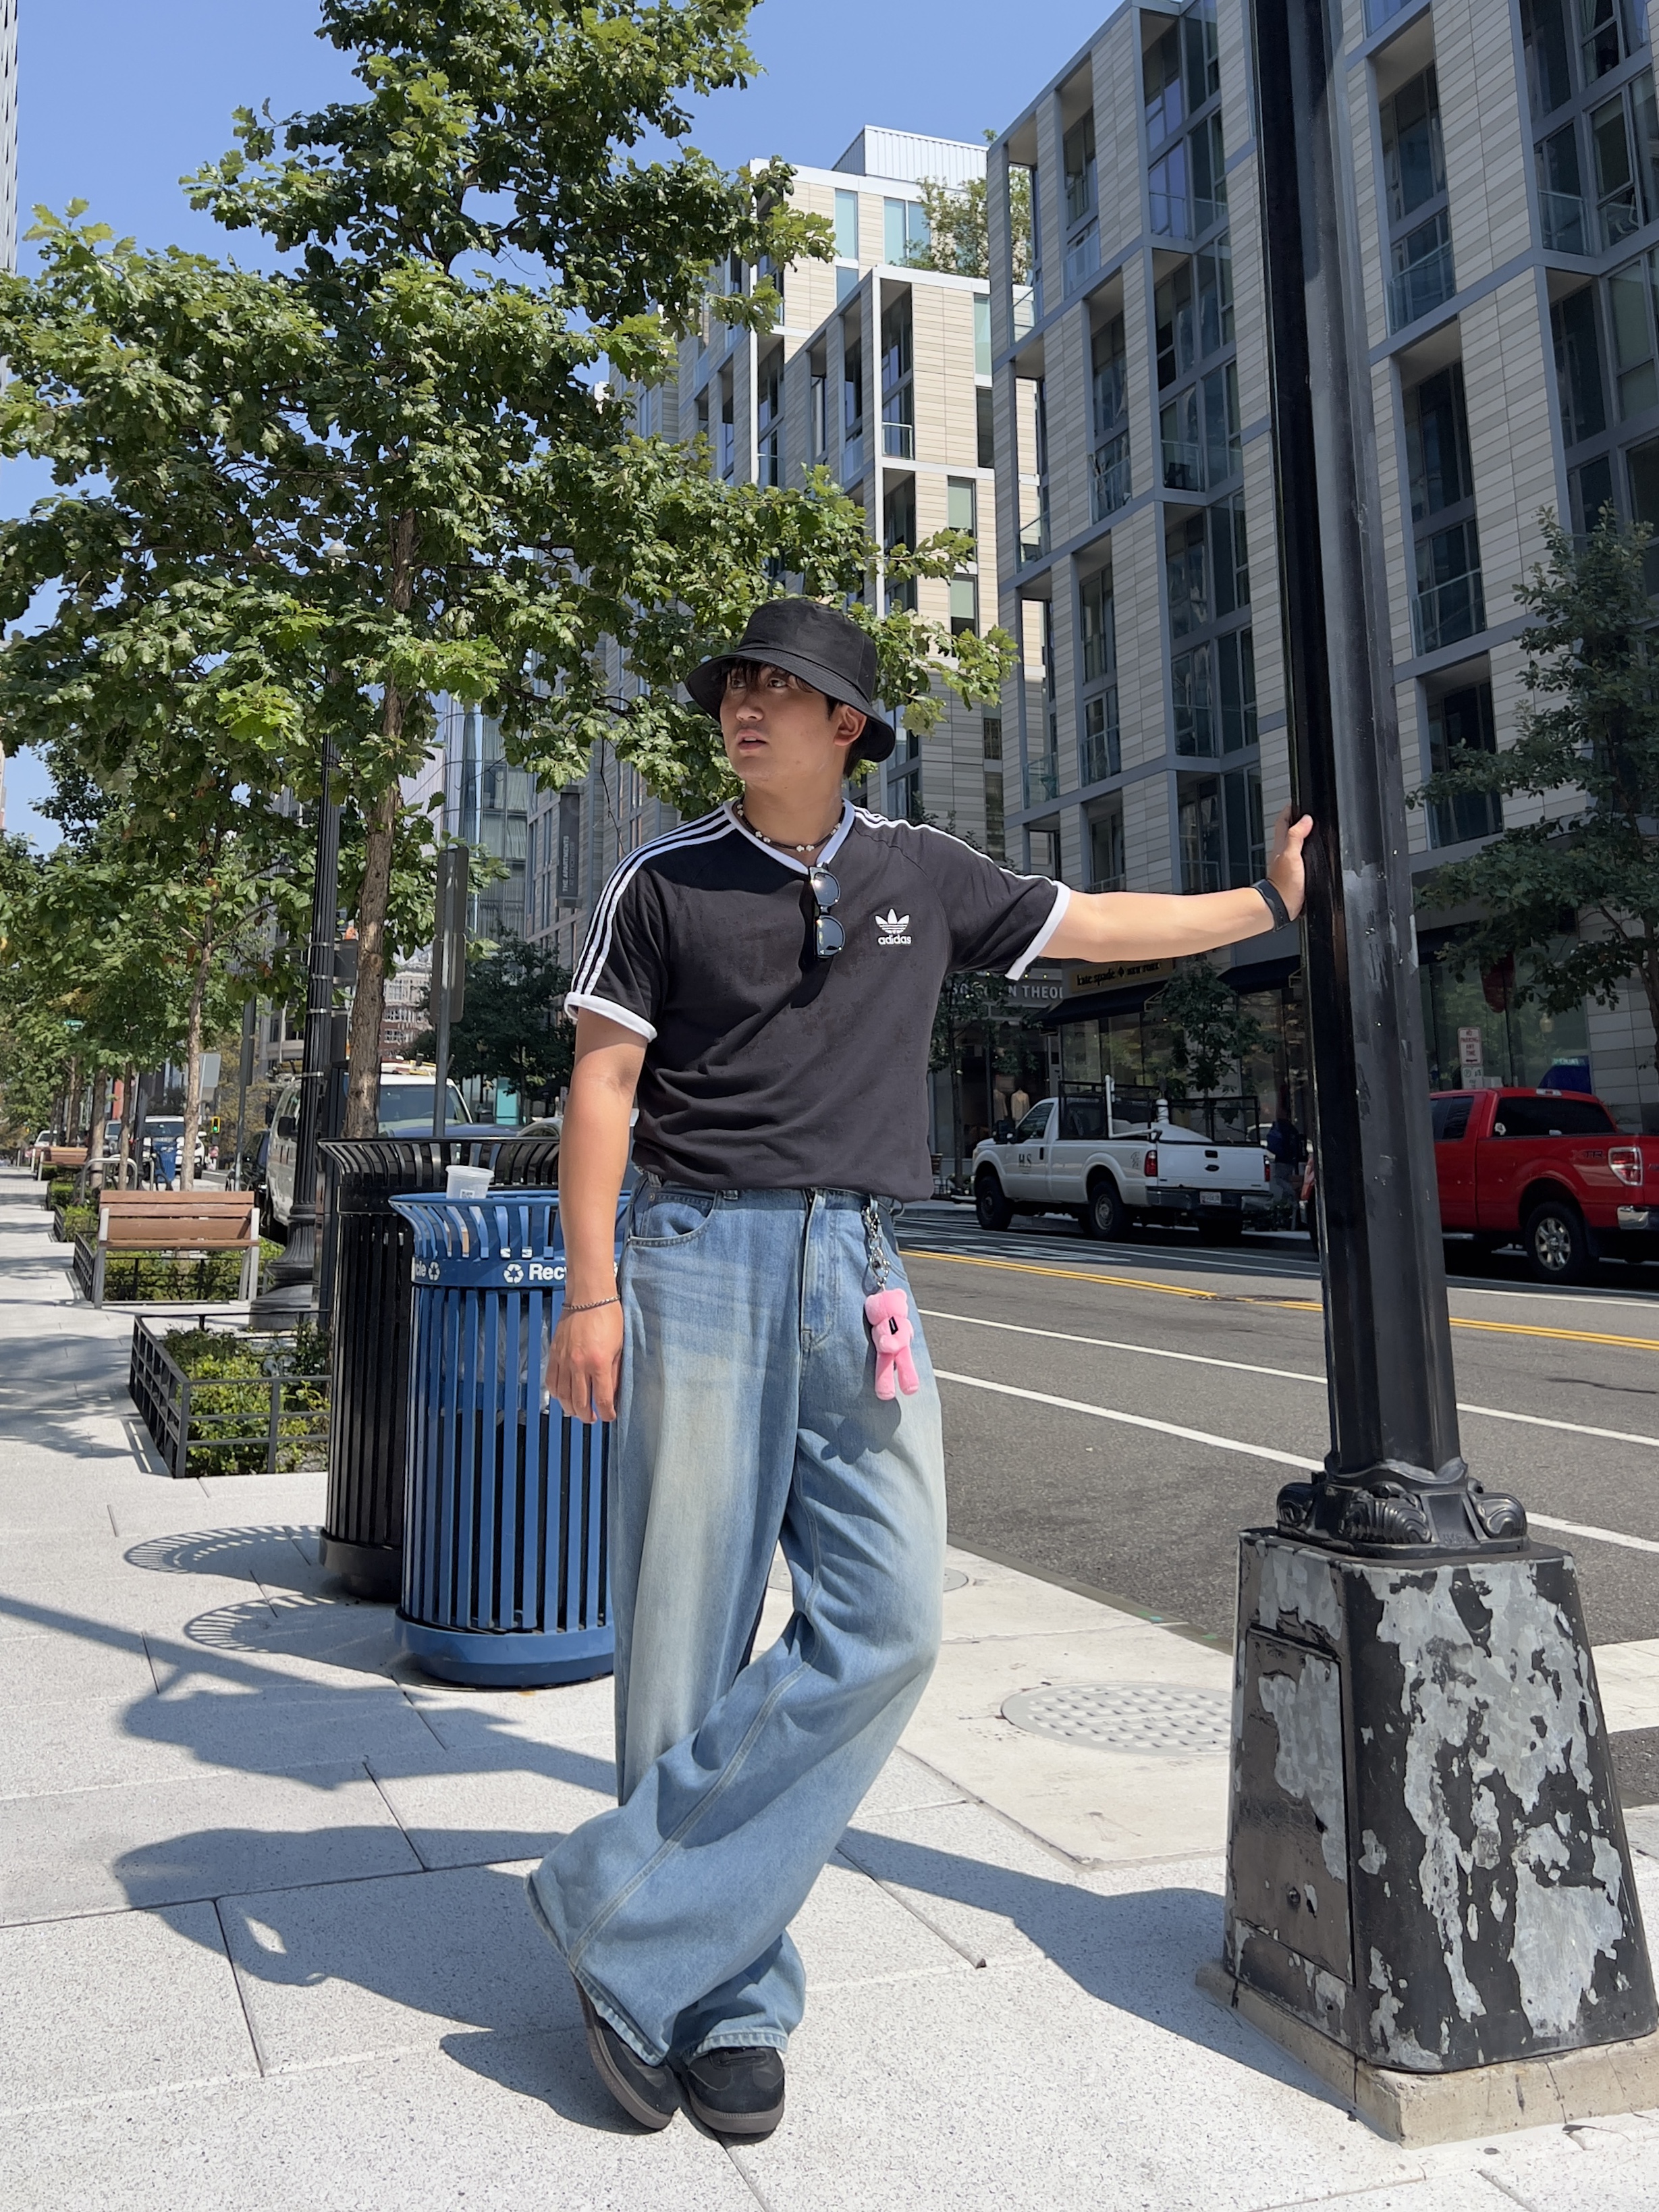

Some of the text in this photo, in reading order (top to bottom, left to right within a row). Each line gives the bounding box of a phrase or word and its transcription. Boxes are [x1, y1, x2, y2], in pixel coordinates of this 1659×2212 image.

[877, 934, 912, 945] adidas
[1077, 974, 1093, 986] kate
[1093, 968, 1116, 986] spade
